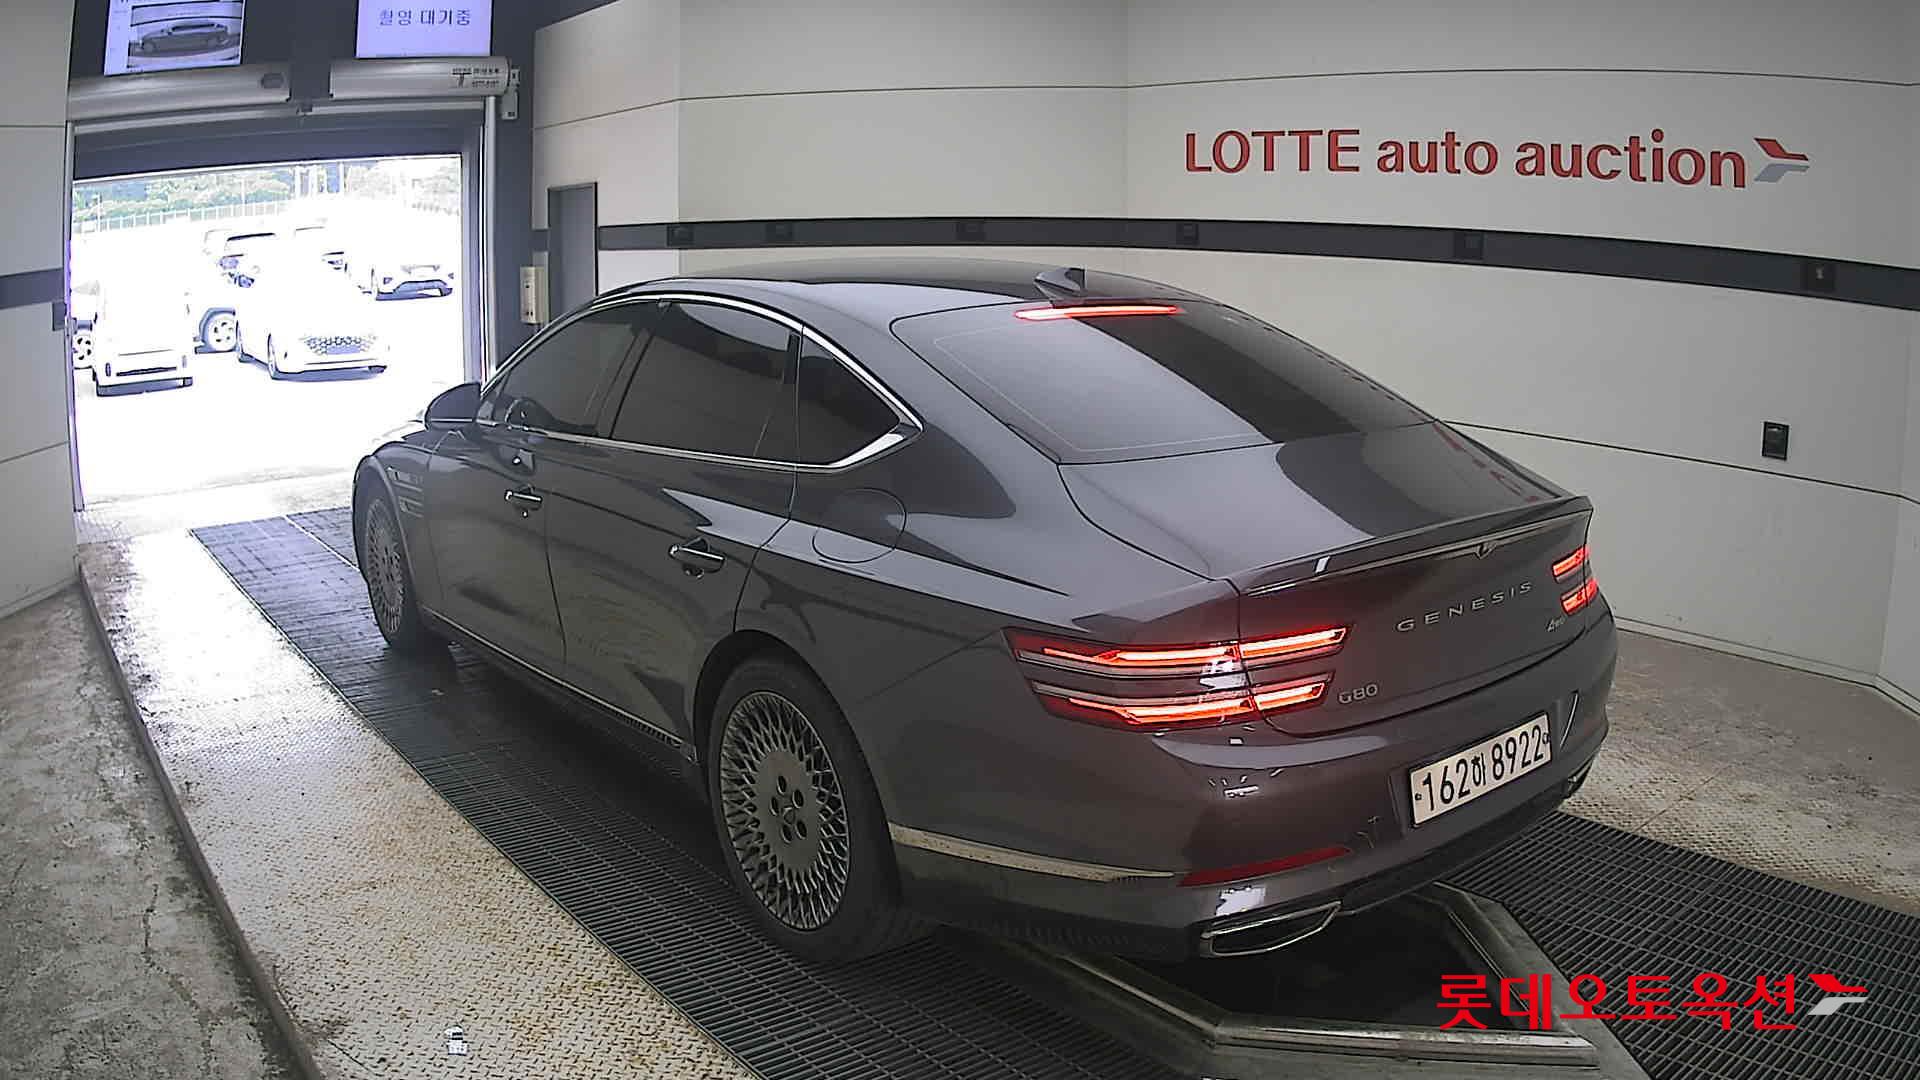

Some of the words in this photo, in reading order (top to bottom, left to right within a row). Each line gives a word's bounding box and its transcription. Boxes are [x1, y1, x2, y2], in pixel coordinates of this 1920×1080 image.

[420, 9, 470, 26] 대기중
[1185, 128, 1361, 173] LOTTE
[1376, 131, 1500, 177] auto
[1515, 129, 1745, 188] auction
[1397, 582, 1532, 632] GENESIS
[1338, 683, 1379, 704] G80
[1422, 752, 1487, 812] 162하
[1491, 724, 1545, 781] 8922
